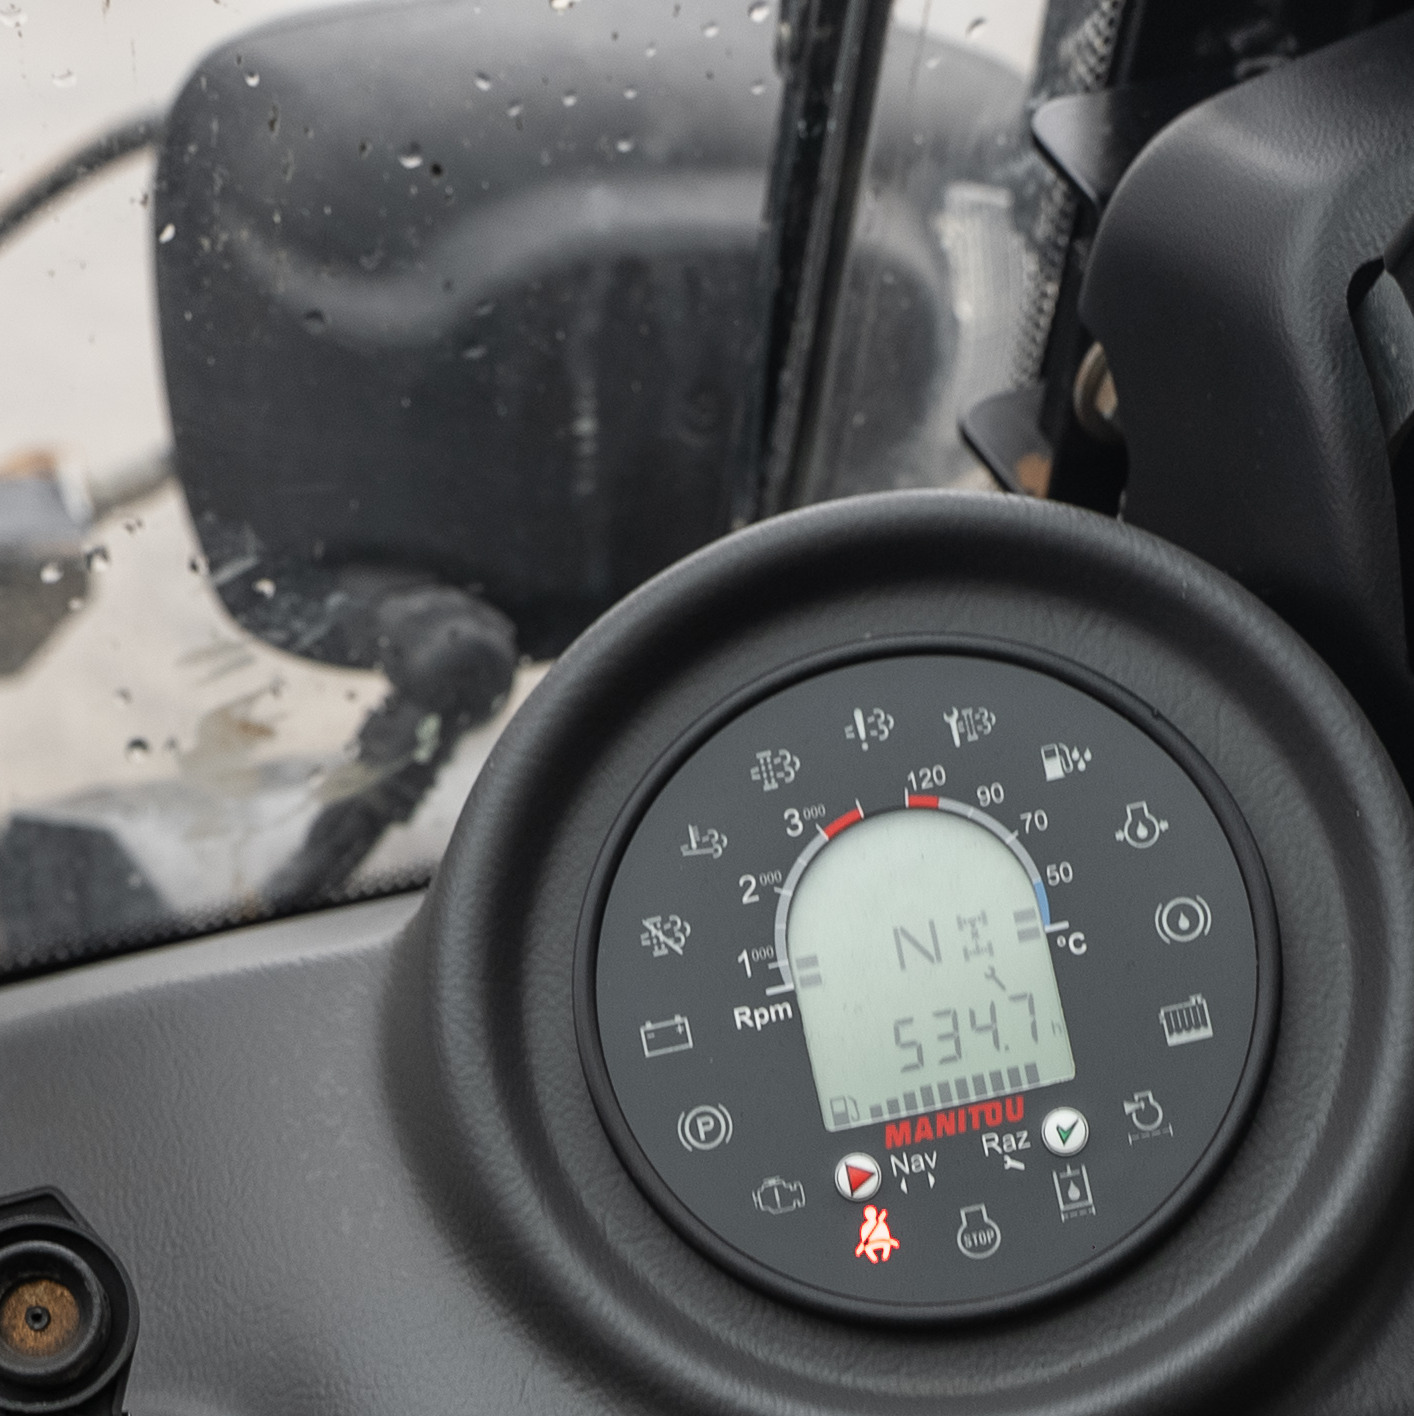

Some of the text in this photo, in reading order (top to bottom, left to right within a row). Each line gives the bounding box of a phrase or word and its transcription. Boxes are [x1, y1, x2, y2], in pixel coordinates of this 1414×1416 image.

[907, 764, 947, 791] 120
[976, 782, 1005, 807] 90
[1020, 809, 1049, 834] 70
[1046, 861, 1074, 886] 50
[892, 919, 942, 971] N
[733, 1001, 793, 1031] Rpm
[696, 1115, 715, 1142] P
[885, 1094, 1024, 1150] MANITOU
[981, 1130, 1031, 1157] Raz
[890, 1150, 937, 1177] Nav
[963, 1228, 995, 1249] STOP
